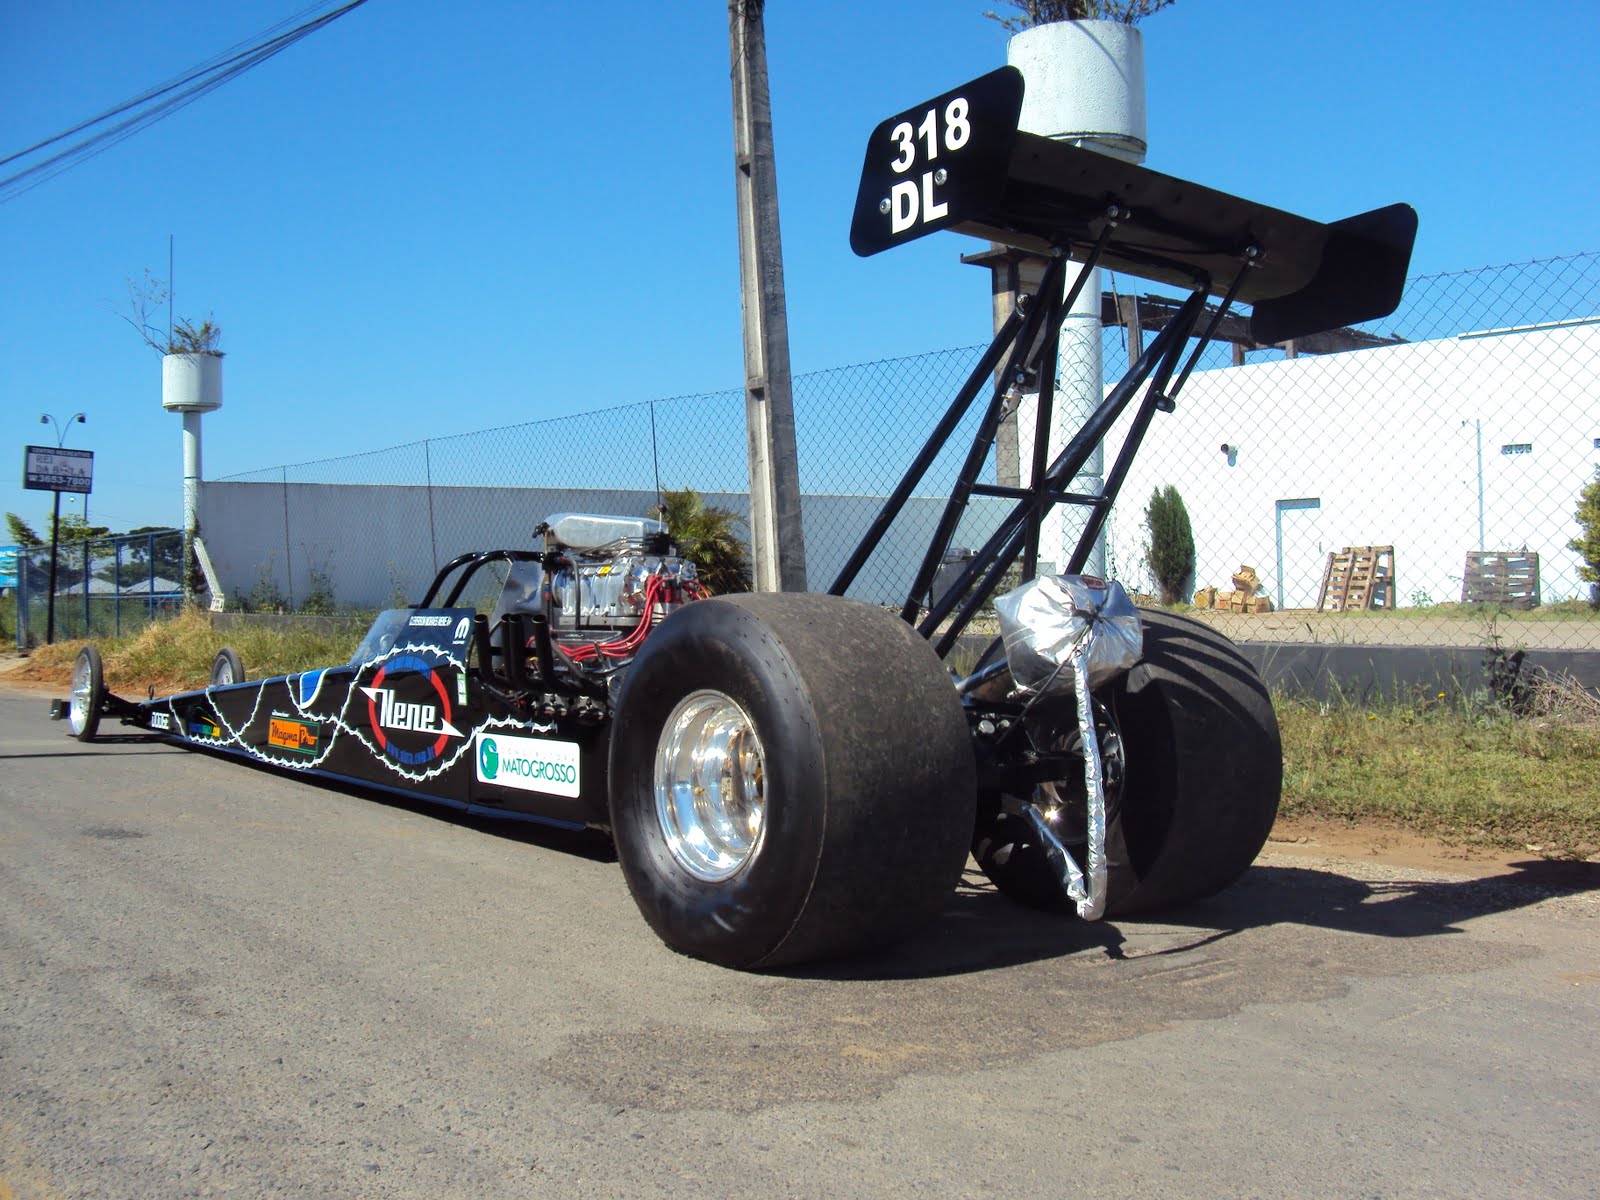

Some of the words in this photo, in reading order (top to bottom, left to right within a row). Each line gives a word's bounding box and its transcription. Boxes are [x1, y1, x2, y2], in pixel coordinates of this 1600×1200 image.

[890, 97, 971, 174] 318
[891, 171, 948, 235] DL
[372, 686, 440, 732] Nene
[501, 757, 577, 784] MATOGROSSO
